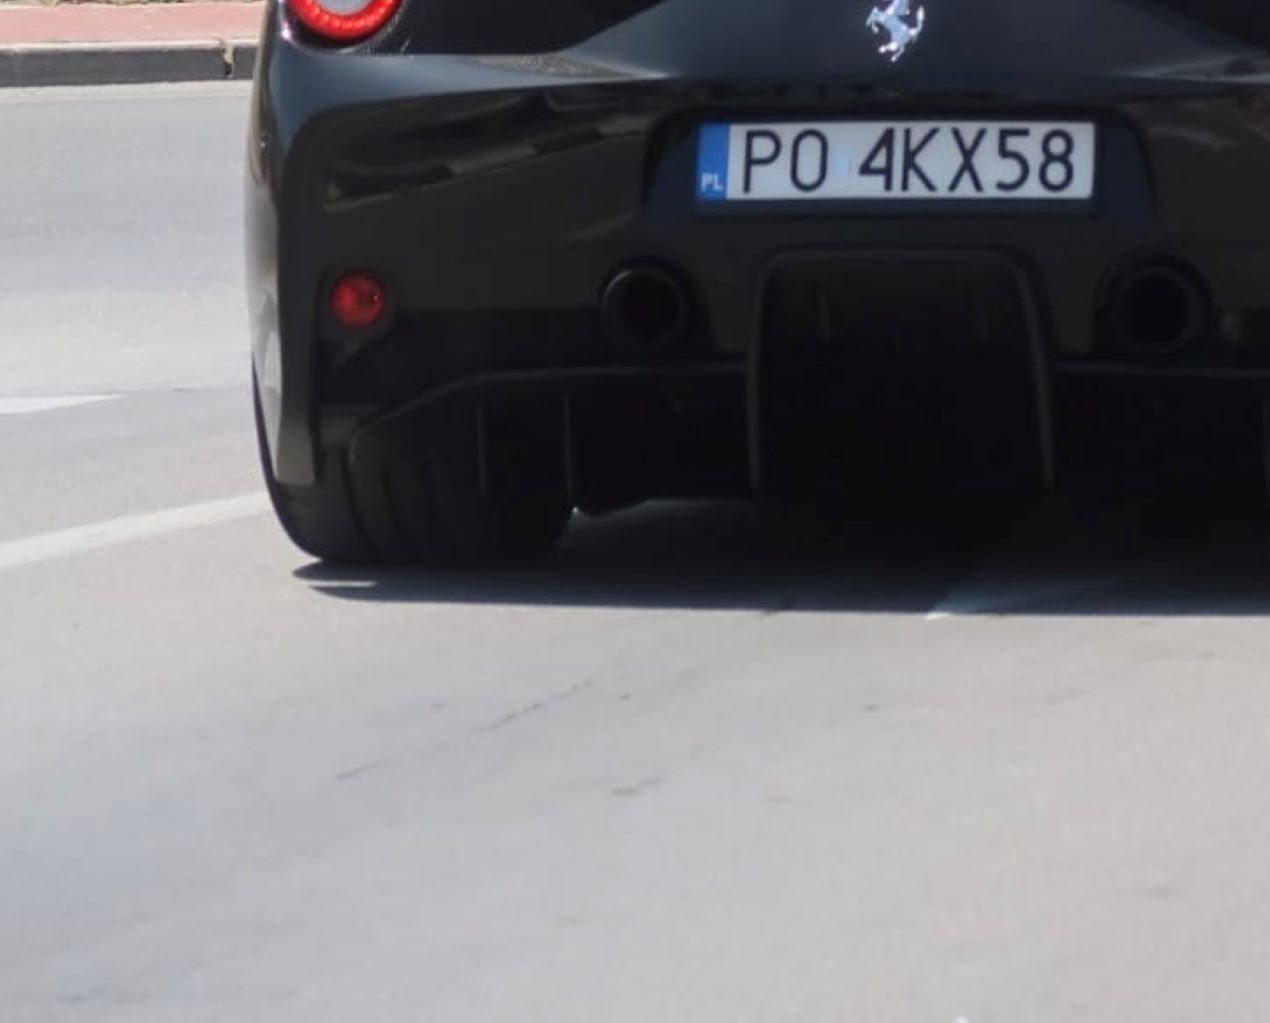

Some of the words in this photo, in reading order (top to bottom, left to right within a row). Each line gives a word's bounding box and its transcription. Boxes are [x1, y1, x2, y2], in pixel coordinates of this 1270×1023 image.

[743, 128, 829, 194] PO
[857, 127, 1075, 193] 4KX58
[700, 173, 724, 192] PL
